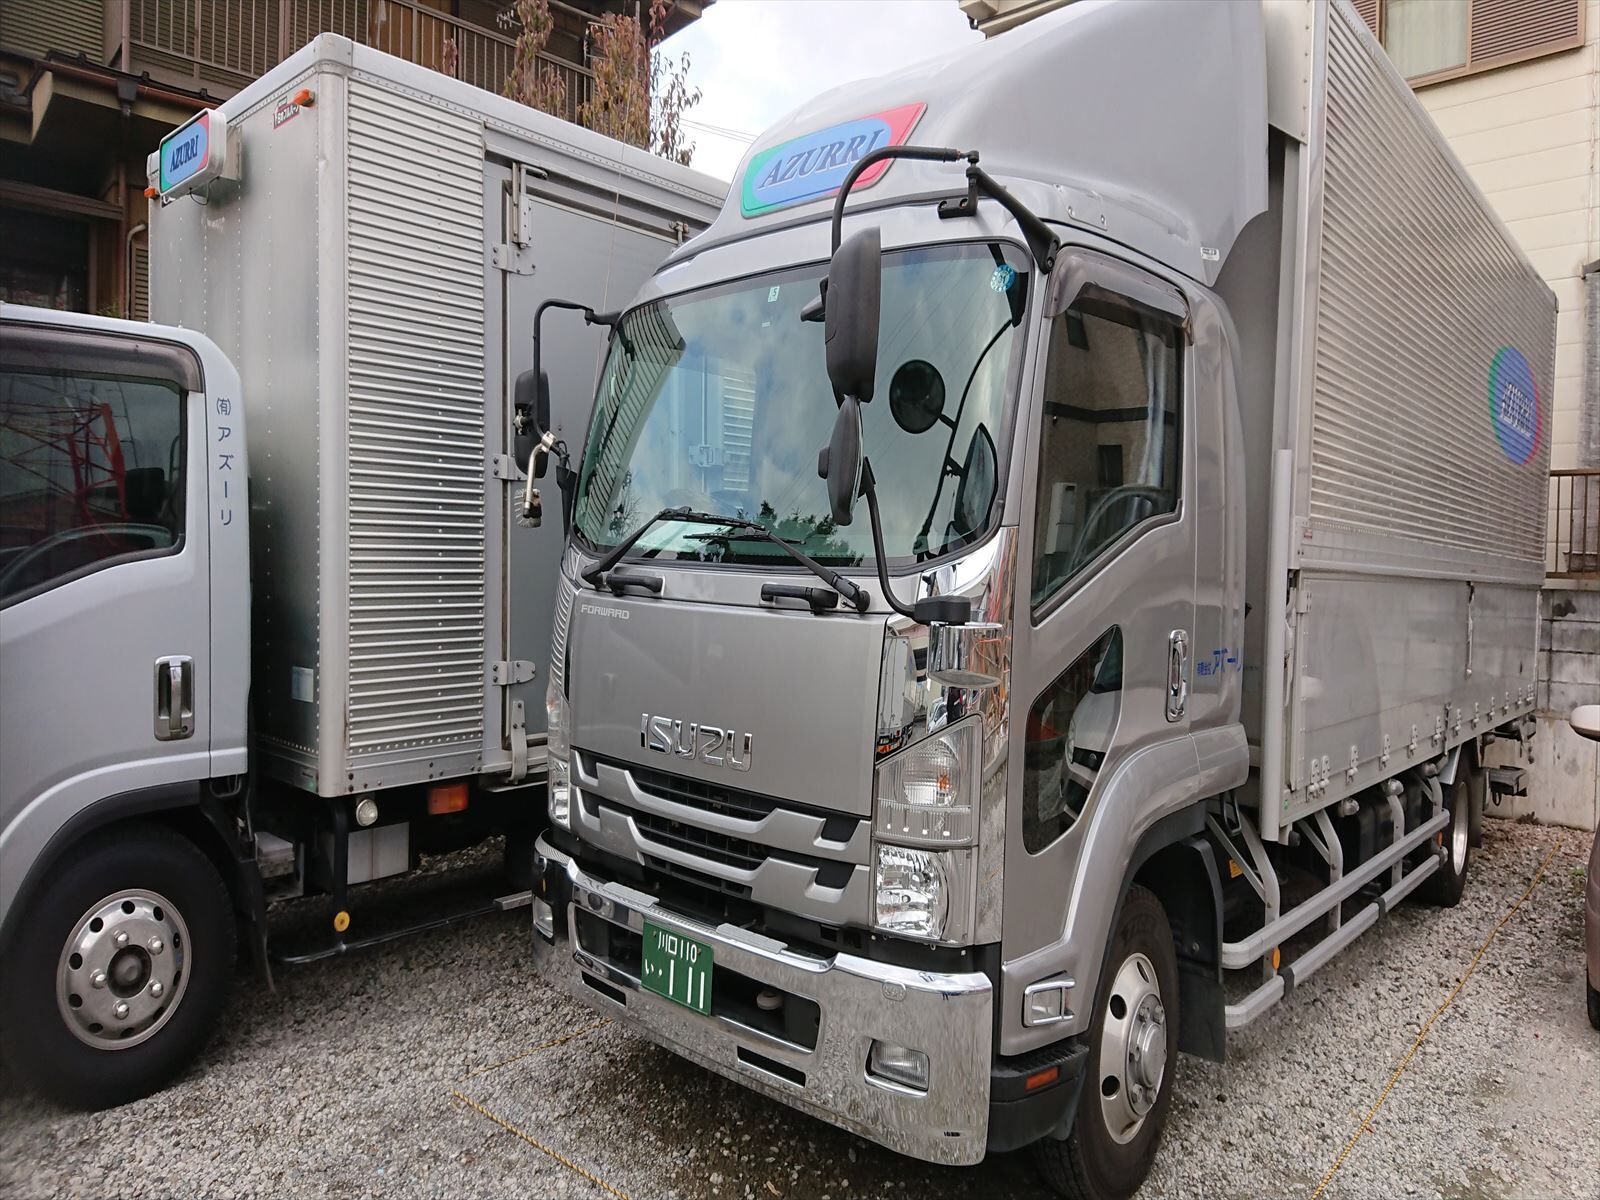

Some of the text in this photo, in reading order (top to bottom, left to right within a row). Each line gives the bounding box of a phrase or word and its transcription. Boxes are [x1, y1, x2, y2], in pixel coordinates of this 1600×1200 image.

[170, 135, 200, 172] AZURRI
[757, 128, 884, 191] AZURRI
[581, 604, 630, 619] FORWARD
[640, 713, 753, 773] ISUZU
